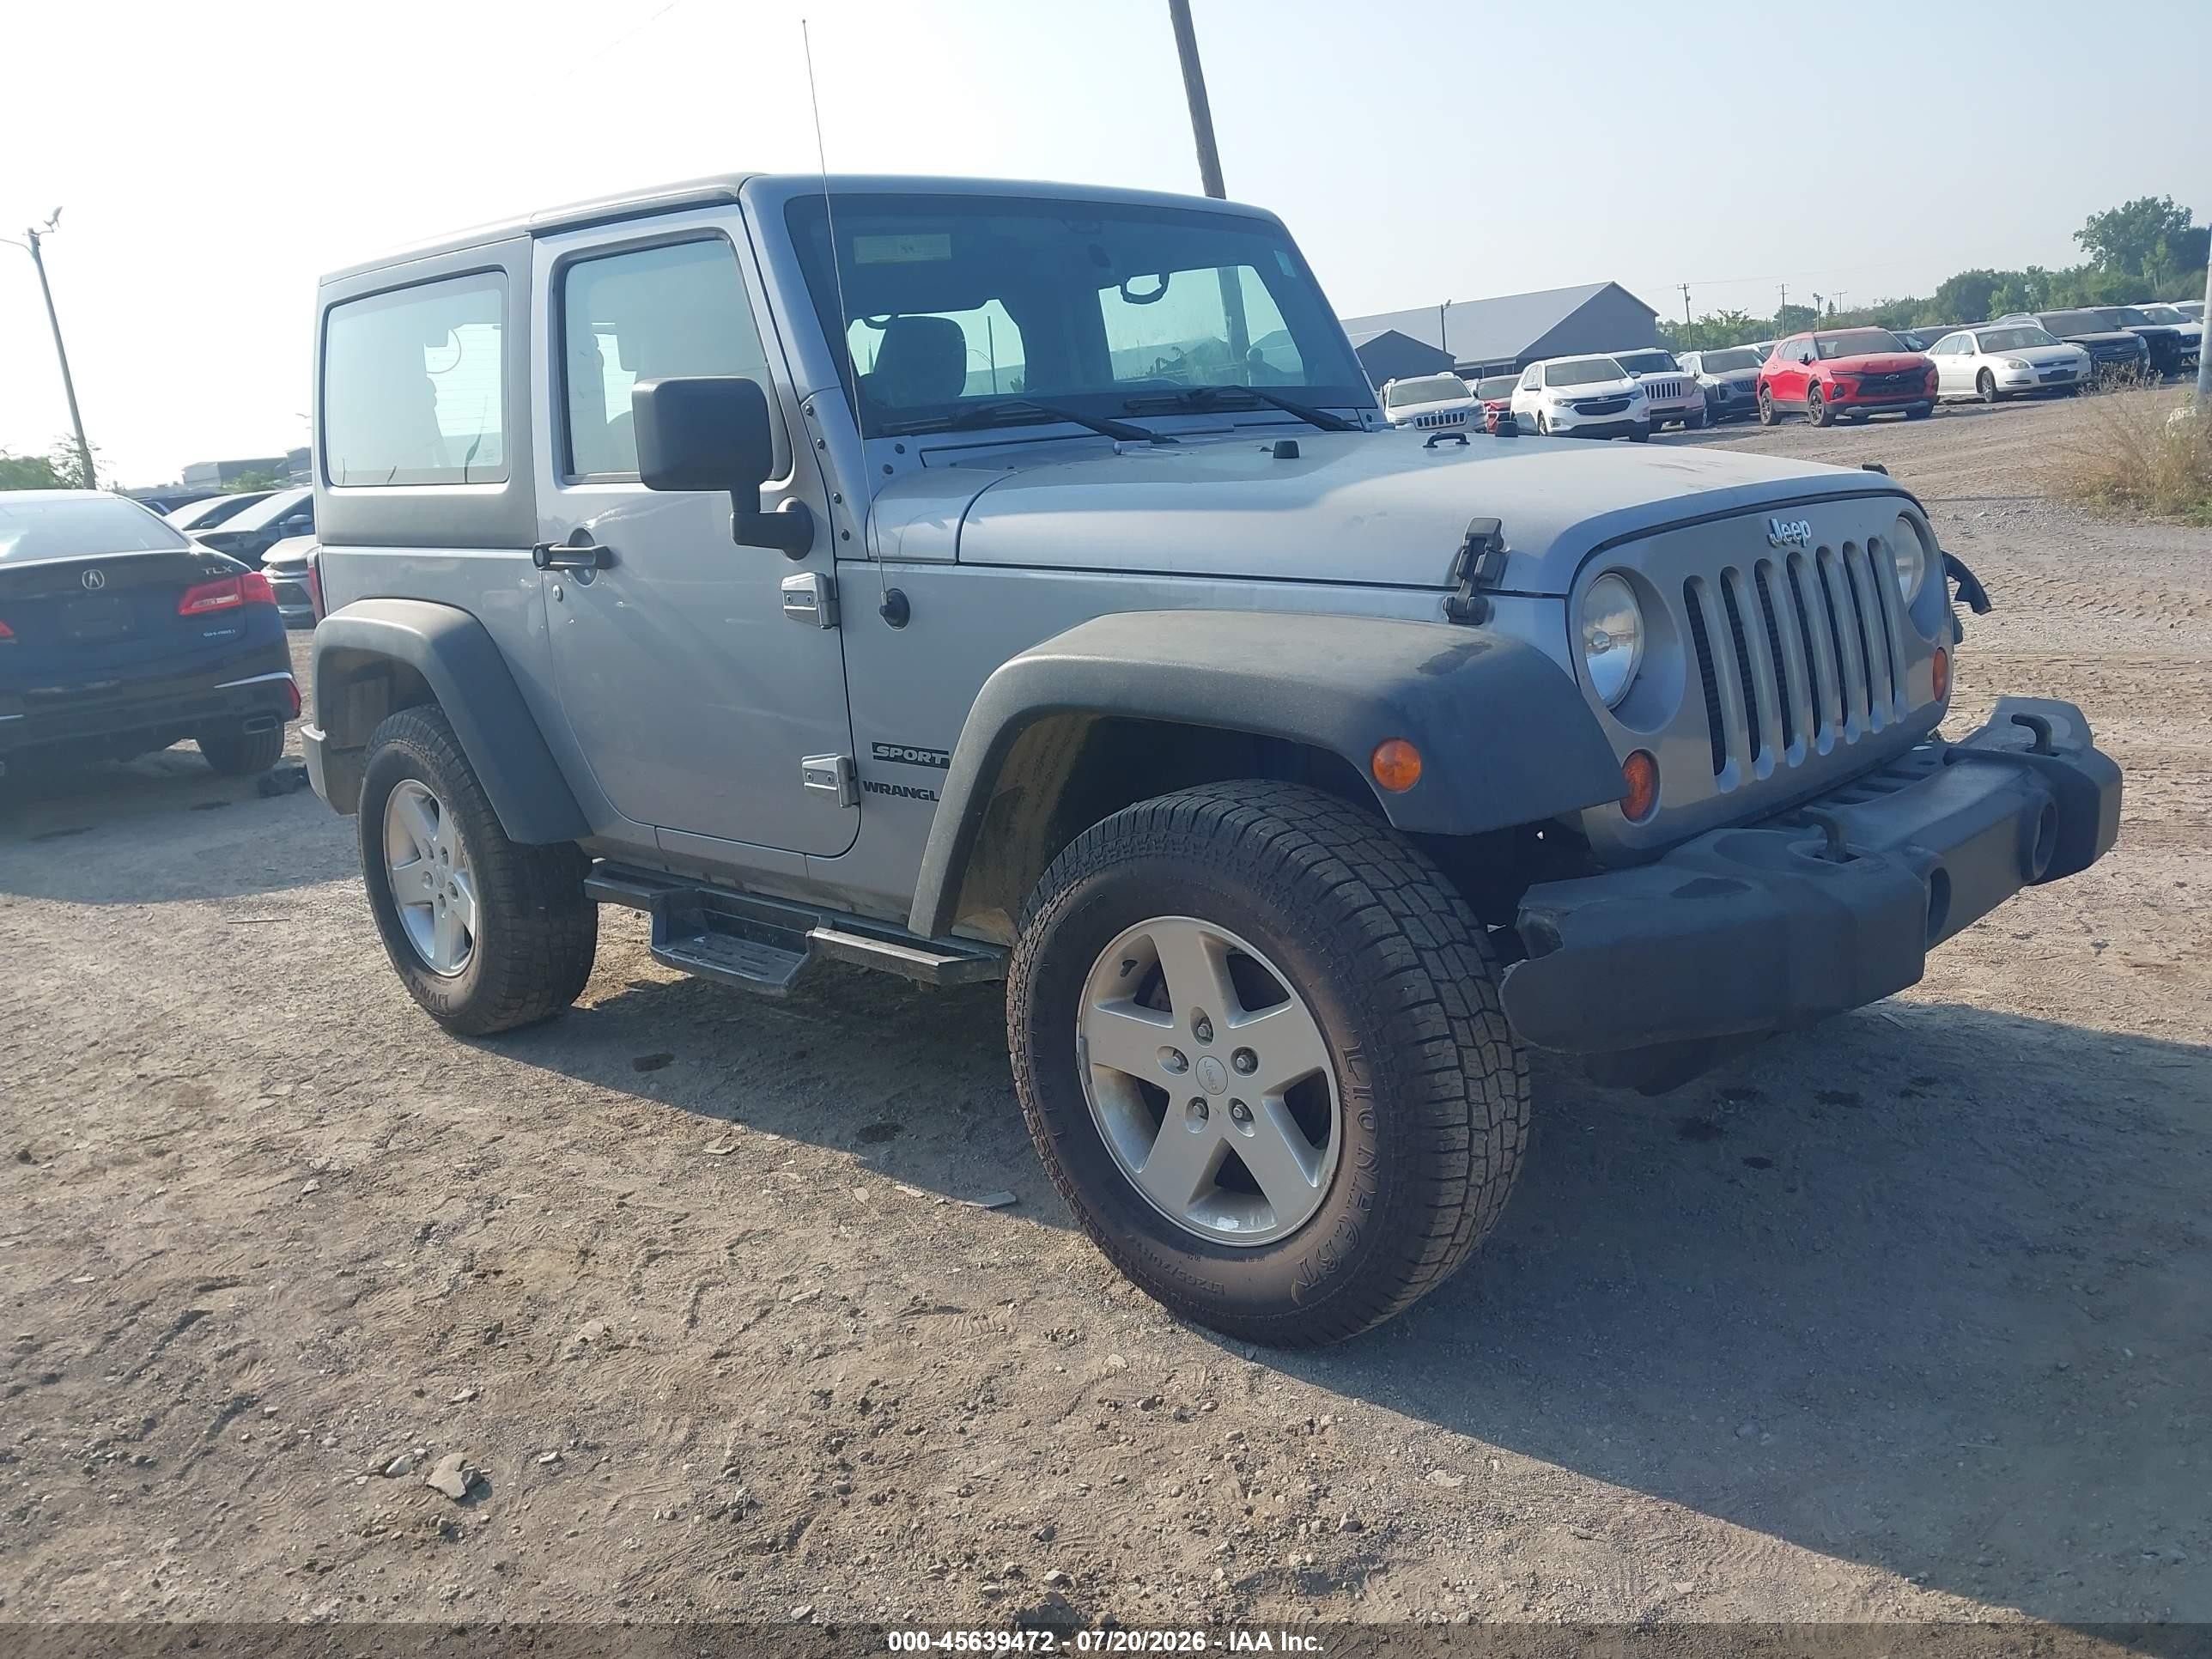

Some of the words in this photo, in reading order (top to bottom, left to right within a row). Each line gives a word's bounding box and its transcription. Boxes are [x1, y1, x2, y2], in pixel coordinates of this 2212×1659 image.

[1768, 518, 1812, 547] Jeep
[200, 565, 234, 574] TLX
[873, 745, 950, 764] SPORT
[862, 780, 940, 803] WRANGL
